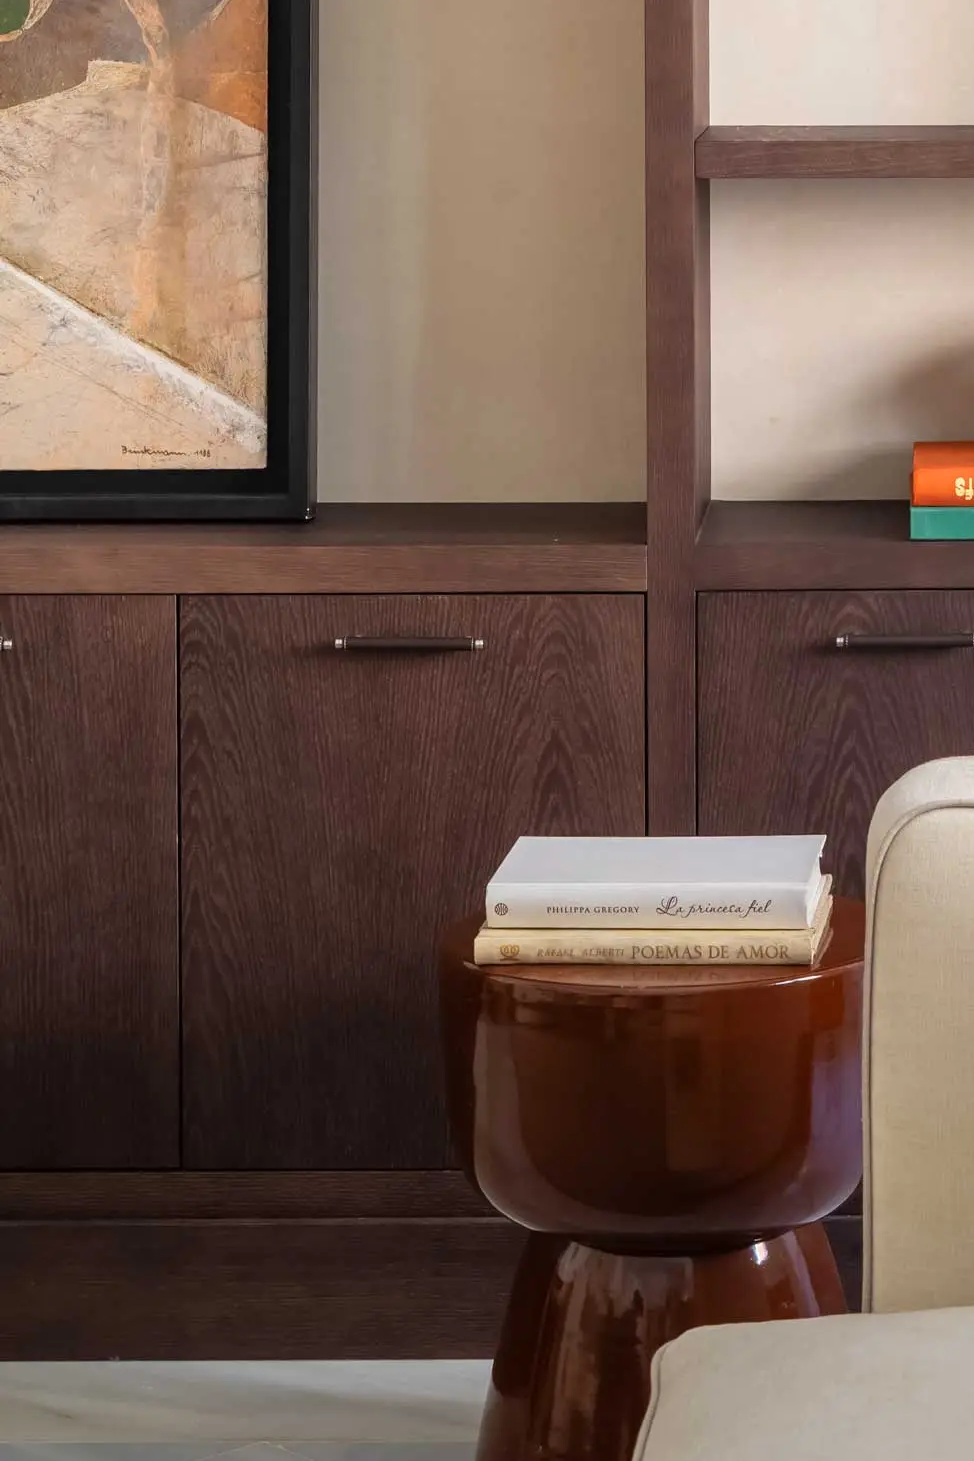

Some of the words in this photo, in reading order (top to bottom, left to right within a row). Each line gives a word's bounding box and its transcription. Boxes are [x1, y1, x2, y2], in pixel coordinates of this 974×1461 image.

[546, 906, 591, 914] PHILIPPA
[593, 906, 640, 914] GREGORY
[656, 896, 685, 916] La
[682, 902, 742, 918] princesa
[739, 899, 772, 918] fiel
[631, 945, 702, 960] POEMAS
[708, 945, 729, 959] DE
[736, 945, 790, 960] AMOR
